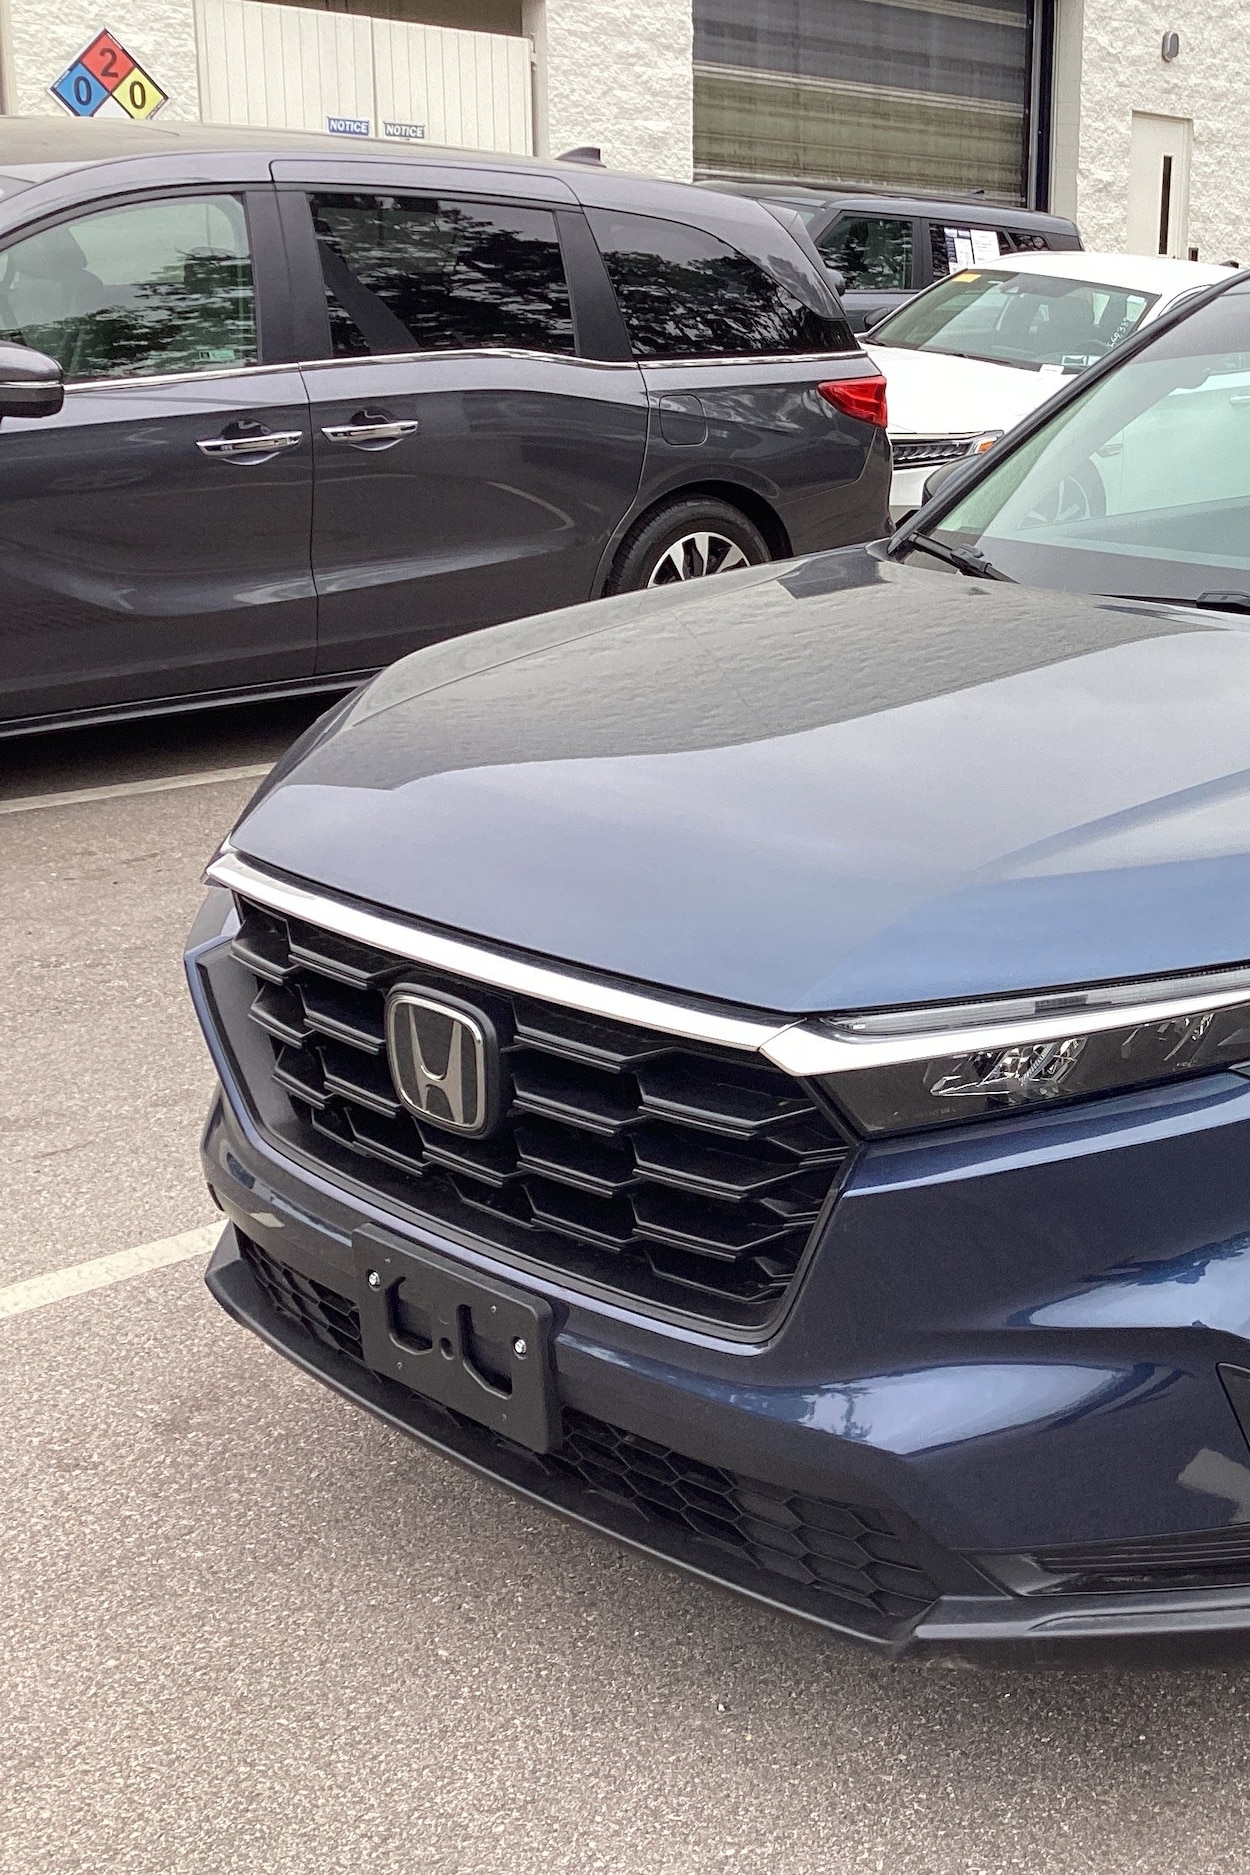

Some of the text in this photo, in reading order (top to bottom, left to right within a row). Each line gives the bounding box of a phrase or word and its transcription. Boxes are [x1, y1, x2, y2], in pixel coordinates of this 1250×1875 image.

[100, 47, 119, 78] 2
[74, 76, 92, 106] 0
[129, 80, 146, 110] 0
[329, 119, 368, 134] NOTICE
[386, 123, 423, 137] NOTICE
